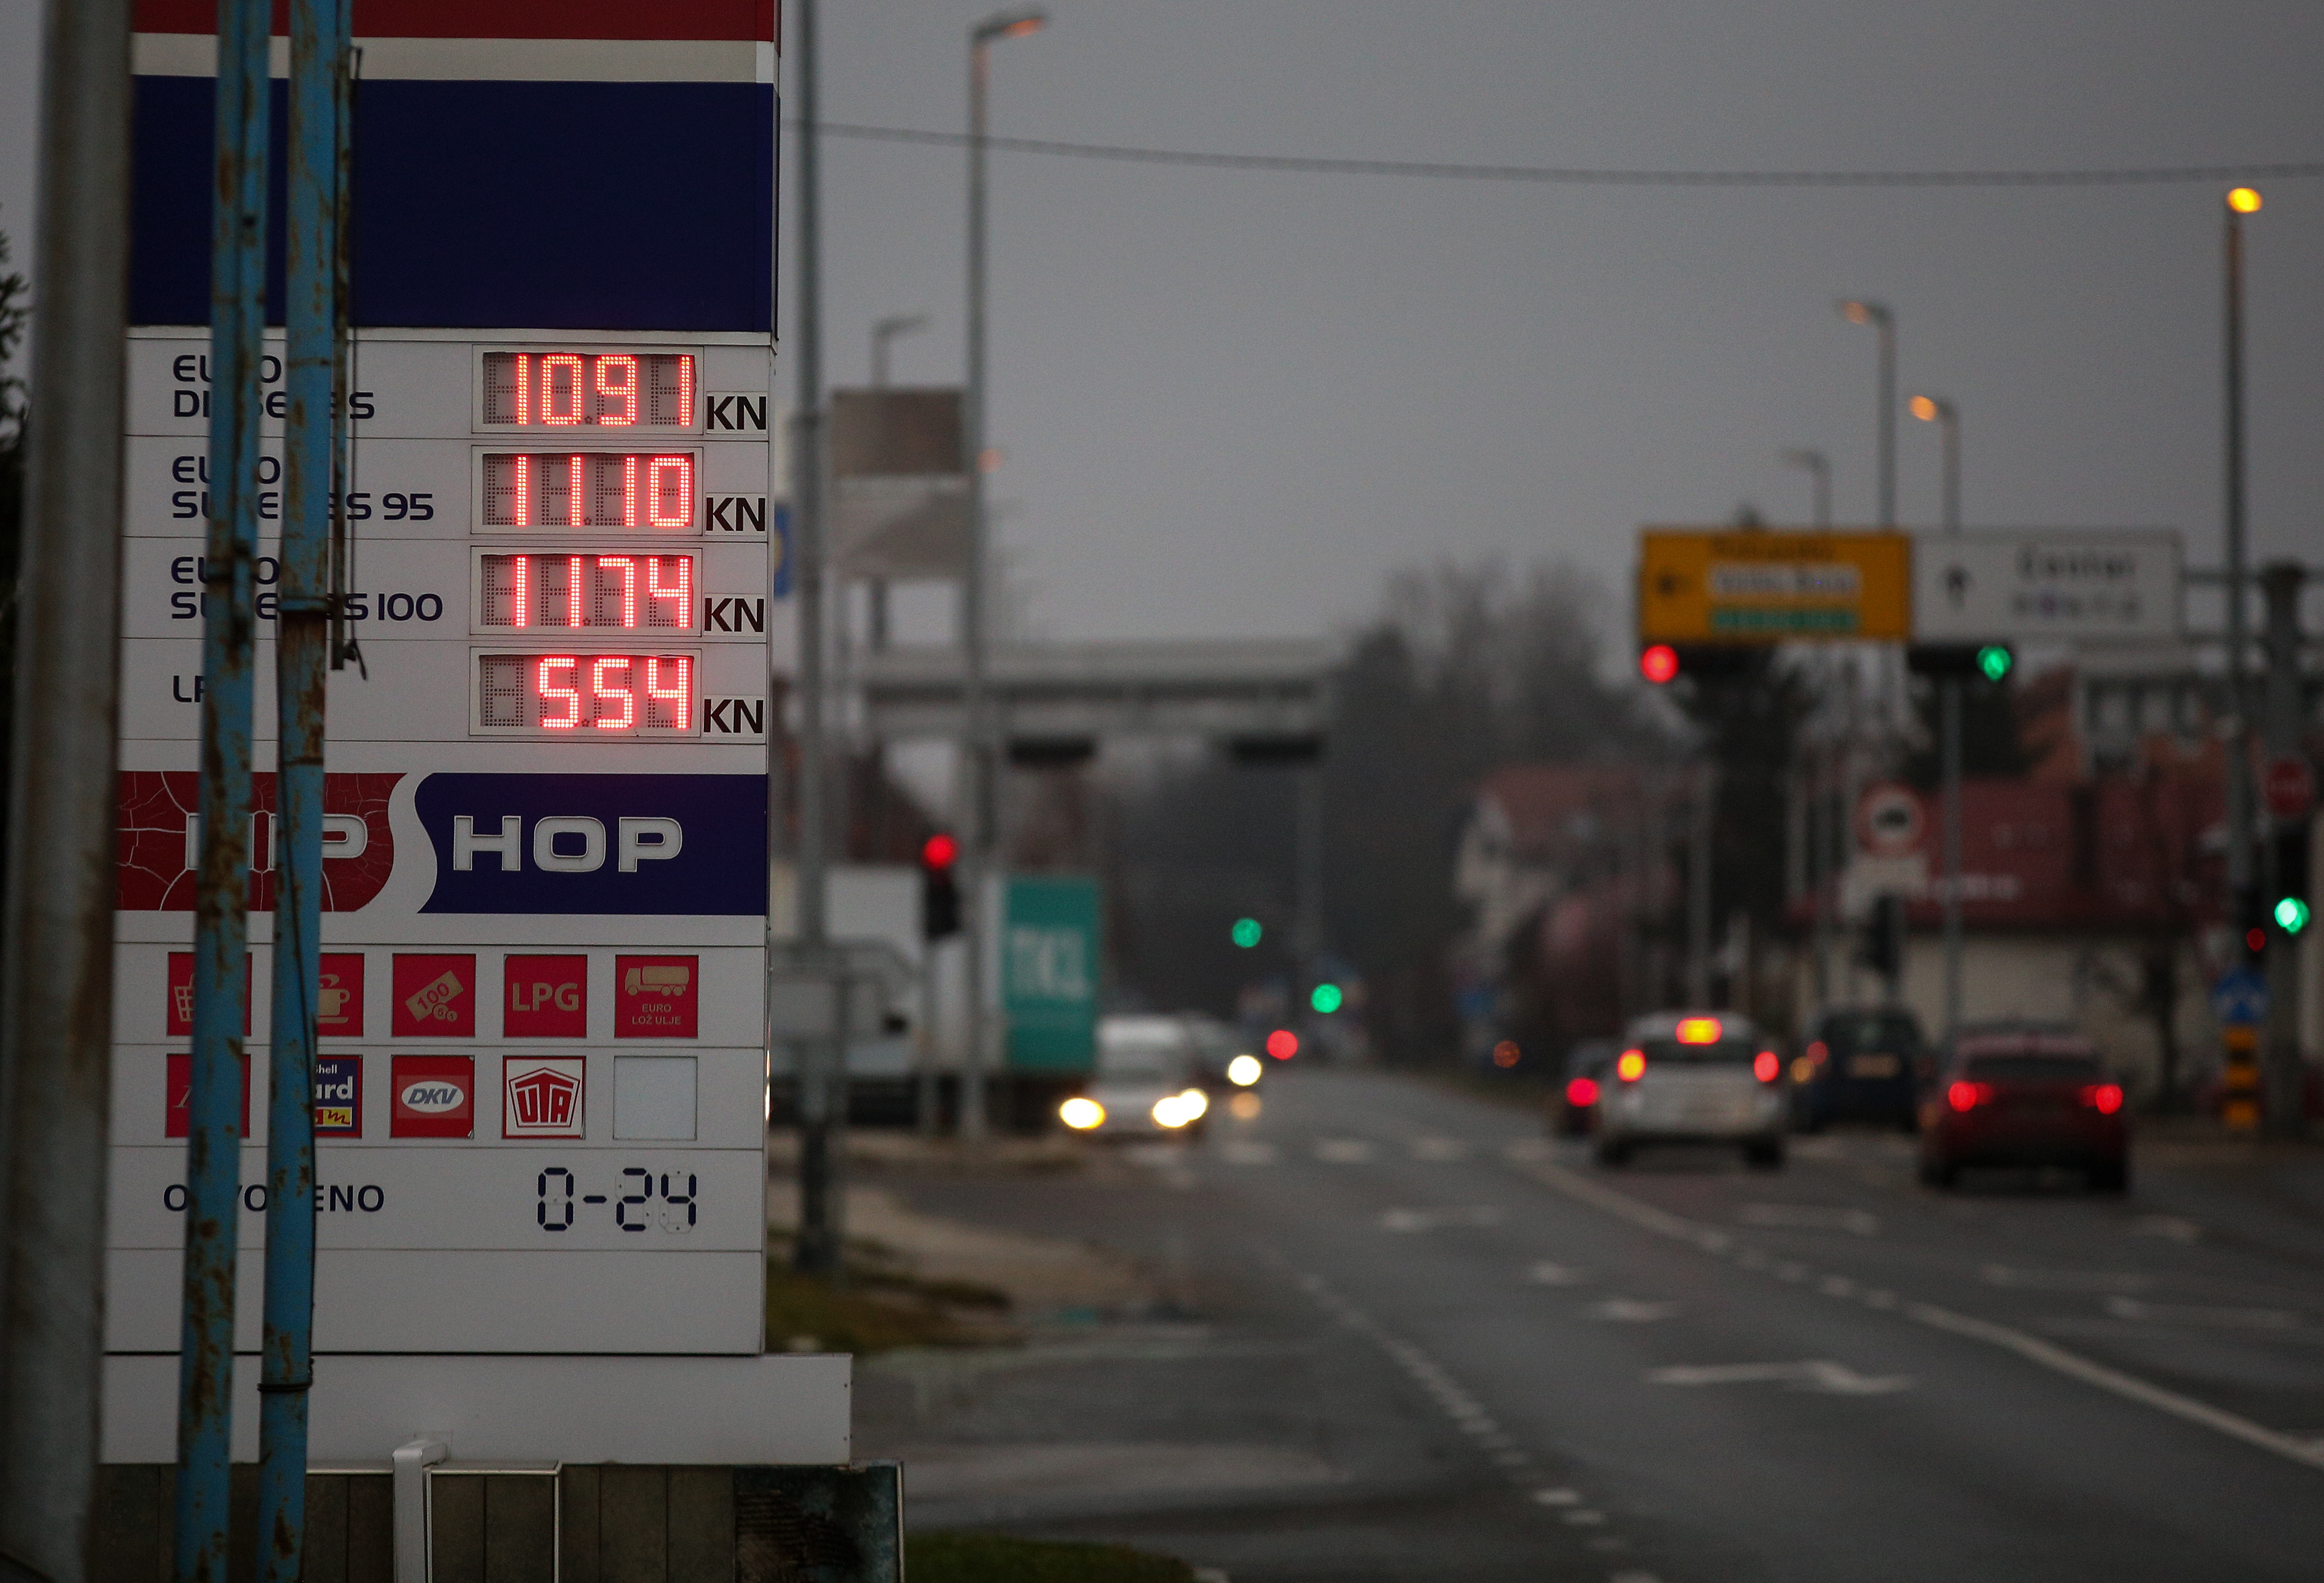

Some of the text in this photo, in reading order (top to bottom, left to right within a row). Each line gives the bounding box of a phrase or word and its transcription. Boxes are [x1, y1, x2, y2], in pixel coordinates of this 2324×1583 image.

[706, 395, 767, 430] KN
[382, 493, 434, 521] 95
[706, 496, 766, 532] KN
[378, 593, 443, 621] 100
[704, 597, 765, 633] KN
[703, 698, 763, 734] KN
[453, 815, 683, 873] HOP
[512, 982, 580, 1012] LPG
[642, 1003, 672, 1013] EURO
[632, 1014, 682, 1025] LOŽ ULJE
[408, 1088, 458, 1104] DKV
[537, 1167, 697, 1232] 0-24
